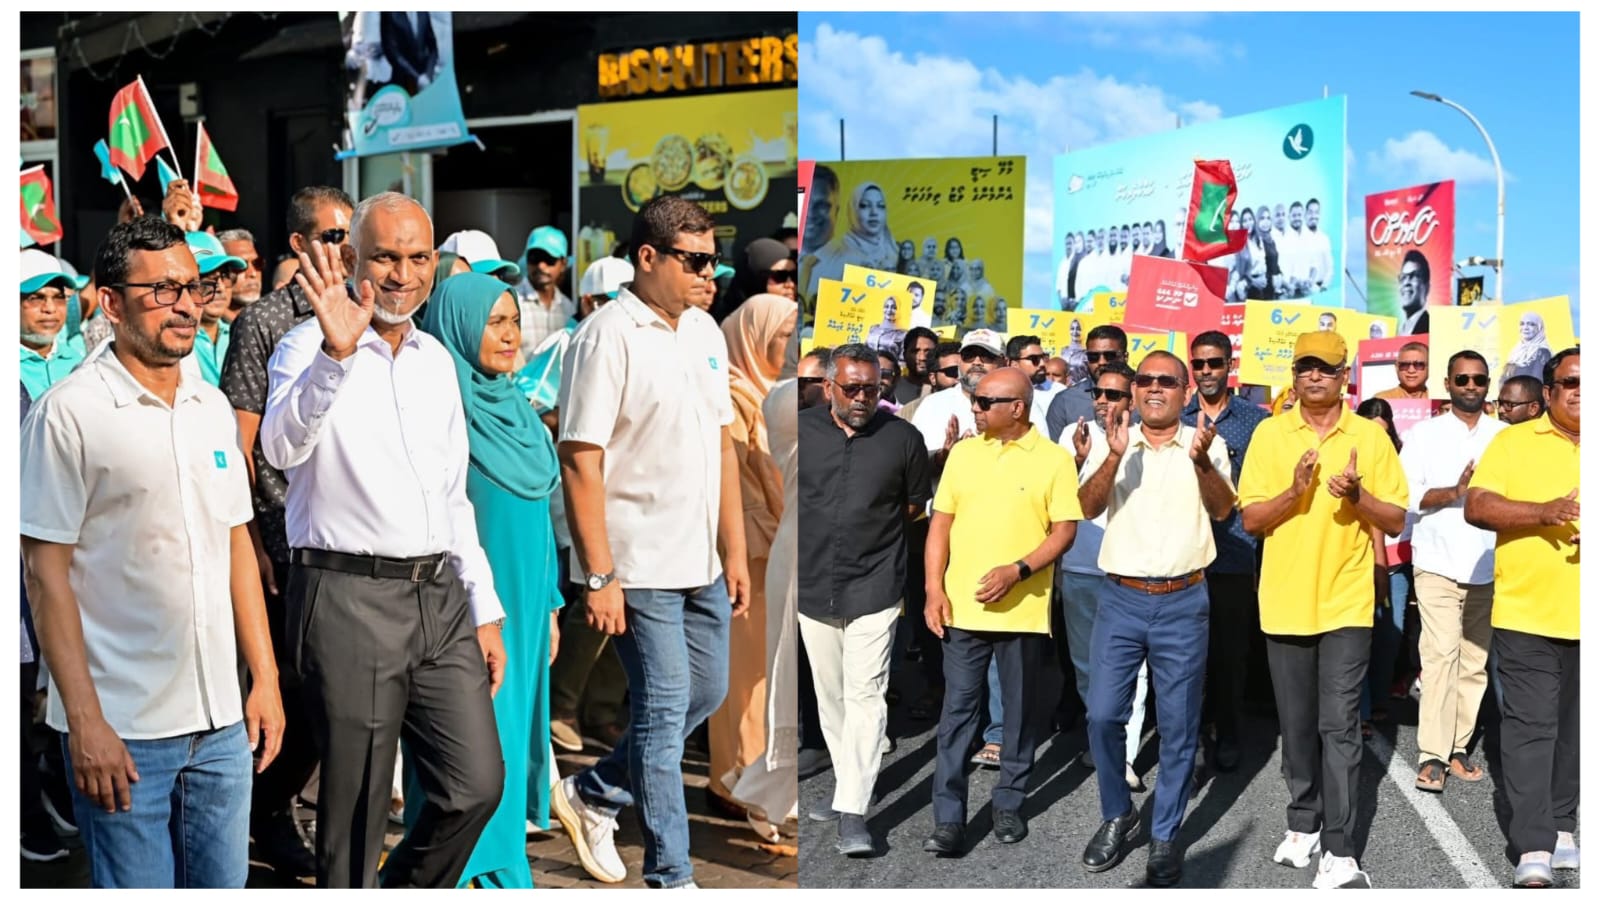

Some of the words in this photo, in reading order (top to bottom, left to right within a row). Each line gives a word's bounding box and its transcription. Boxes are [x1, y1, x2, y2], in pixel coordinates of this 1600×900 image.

[866, 275, 876, 287] 6
[841, 288, 852, 302] 7
[1109, 297, 1117, 307] 6
[1029, 315, 1041, 328] 7
[1271, 309, 1283, 324] 6
[1461, 312, 1475, 330] 7
[1131, 338, 1142, 351] 7
